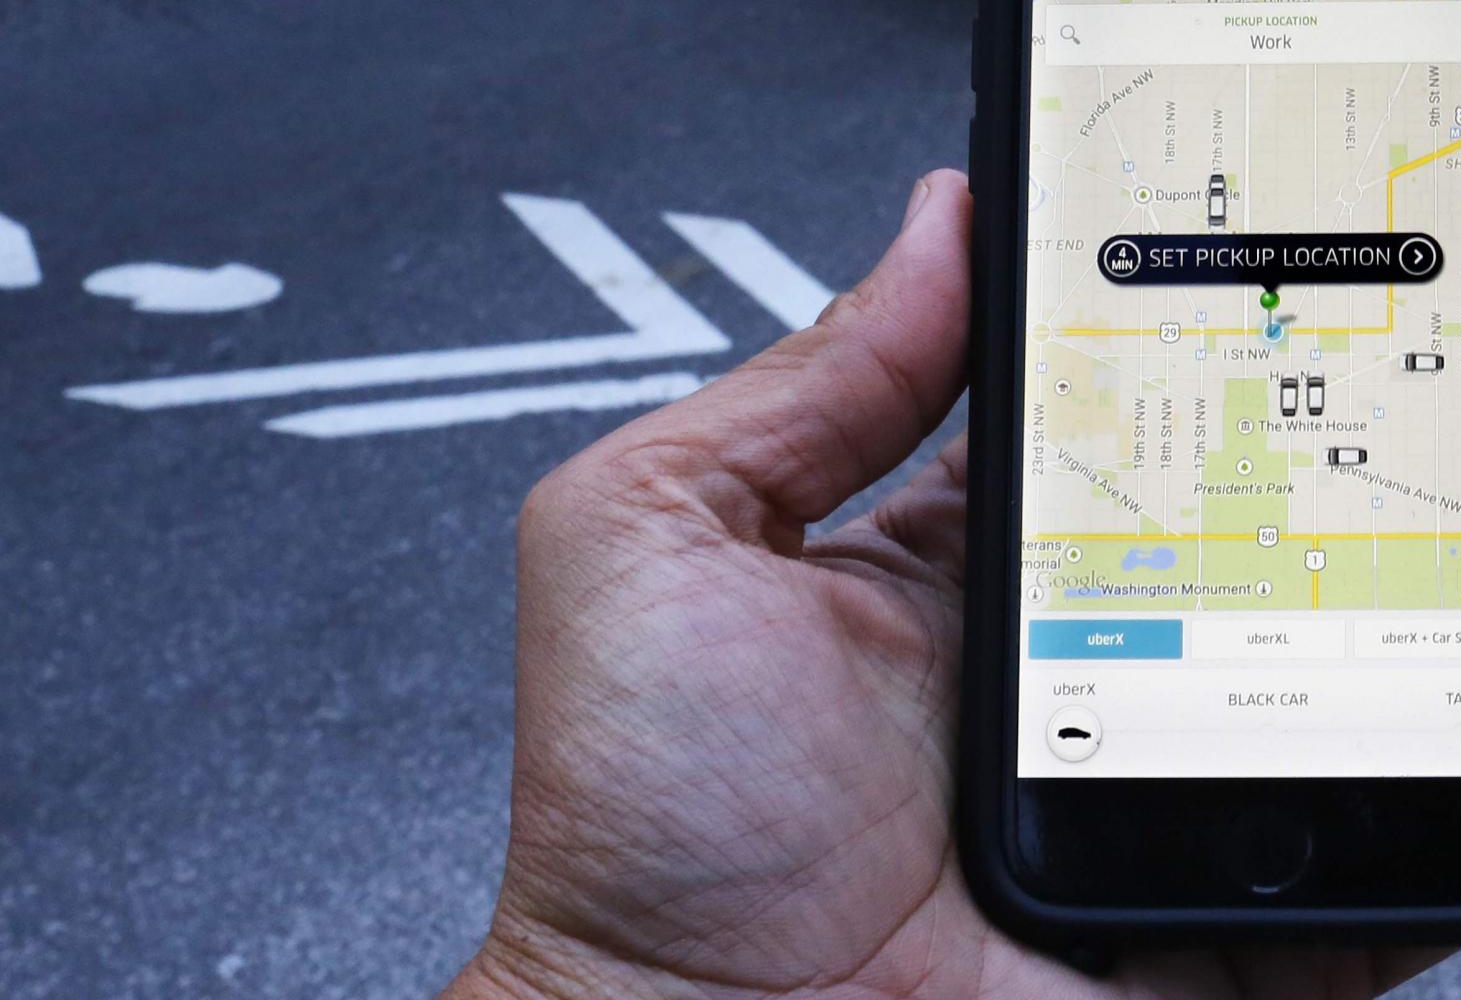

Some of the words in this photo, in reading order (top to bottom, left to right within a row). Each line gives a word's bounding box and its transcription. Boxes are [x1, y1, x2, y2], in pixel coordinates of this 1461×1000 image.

[1224, 16, 1263, 27] PICKUP
[1266, 16, 1318, 26] LOCATION
[1250, 34, 1292, 50] Work
[1429, 65, 1440, 87] NW
[1080, 100, 1112, 138] Florida
[1111, 85, 1133, 105] Ave
[1132, 68, 1155, 89] NW
[1345, 88, 1356, 107] NW
[1429, 90, 1441, 104] St
[1165, 101, 1176, 122] NW
[1212, 109, 1224, 129] NW
[1345, 110, 1356, 123] St
[1429, 108, 1440, 127] 9th
[1165, 124, 1176, 136] St
[1345, 125, 1356, 150] 13th
[1212, 131, 1224, 145] St
[1165, 138, 1176, 164] 18th
[1212, 147, 1223, 172] 17th
[1155, 189, 1201, 203] Dupont
[1056, 239, 1085, 251] END
[1118, 247, 1127, 258] 4
[1150, 249, 1188, 267] SET
[1196, 248, 1275, 267] PICKUP
[1283, 247, 1390, 267] LOCATION
[1111, 260, 1133, 271] MIN
[1431, 312, 1442, 335] NW
[1163, 327, 1177, 338] 29
[1231, 349, 1244, 360] St
[1248, 349, 1271, 360] NW
[1032, 403, 1044, 425] NW
[1134, 398, 1146, 419] NW
[1161, 398, 1172, 419] NW
[1194, 398, 1206, 419] NW
[1134, 423, 1146, 438] St
[1161, 423, 1172, 438] St
[1194, 423, 1206, 438] St
[1259, 421, 1282, 433] The
[1286, 420, 1322, 432] White
[1326, 420, 1367, 432] House
[1032, 428, 1044, 443] St
[1032, 444, 1044, 475] 23rd
[1134, 441, 1146, 469] 19th
[1161, 441, 1172, 469] 18th
[1194, 441, 1206, 469] 17th
[1057, 448, 1097, 483] Virginia
[1099, 478, 1120, 499] Ave
[1120, 493, 1143, 514] NW
[1194, 483, 1263, 495] President's
[1266, 482, 1295, 495] Park
[1330, 464, 1411, 496] Pennsylvania
[1413, 487, 1437, 504] Ave
[1261, 531, 1275, 542] 50
[1036, 570, 1106, 596] Google
[1102, 583, 1177, 597] Washington
[1182, 584, 1251, 596] Monument
[1087, 632, 1124, 645] uberX
[1247, 632, 1290, 645] uberXL
[1381, 632, 1417, 644] uberX
[1432, 632, 1451, 644] Car
[1053, 683, 1096, 696] uberX
[1228, 693, 1274, 706] BLACK
[1280, 693, 1309, 706] CAR
